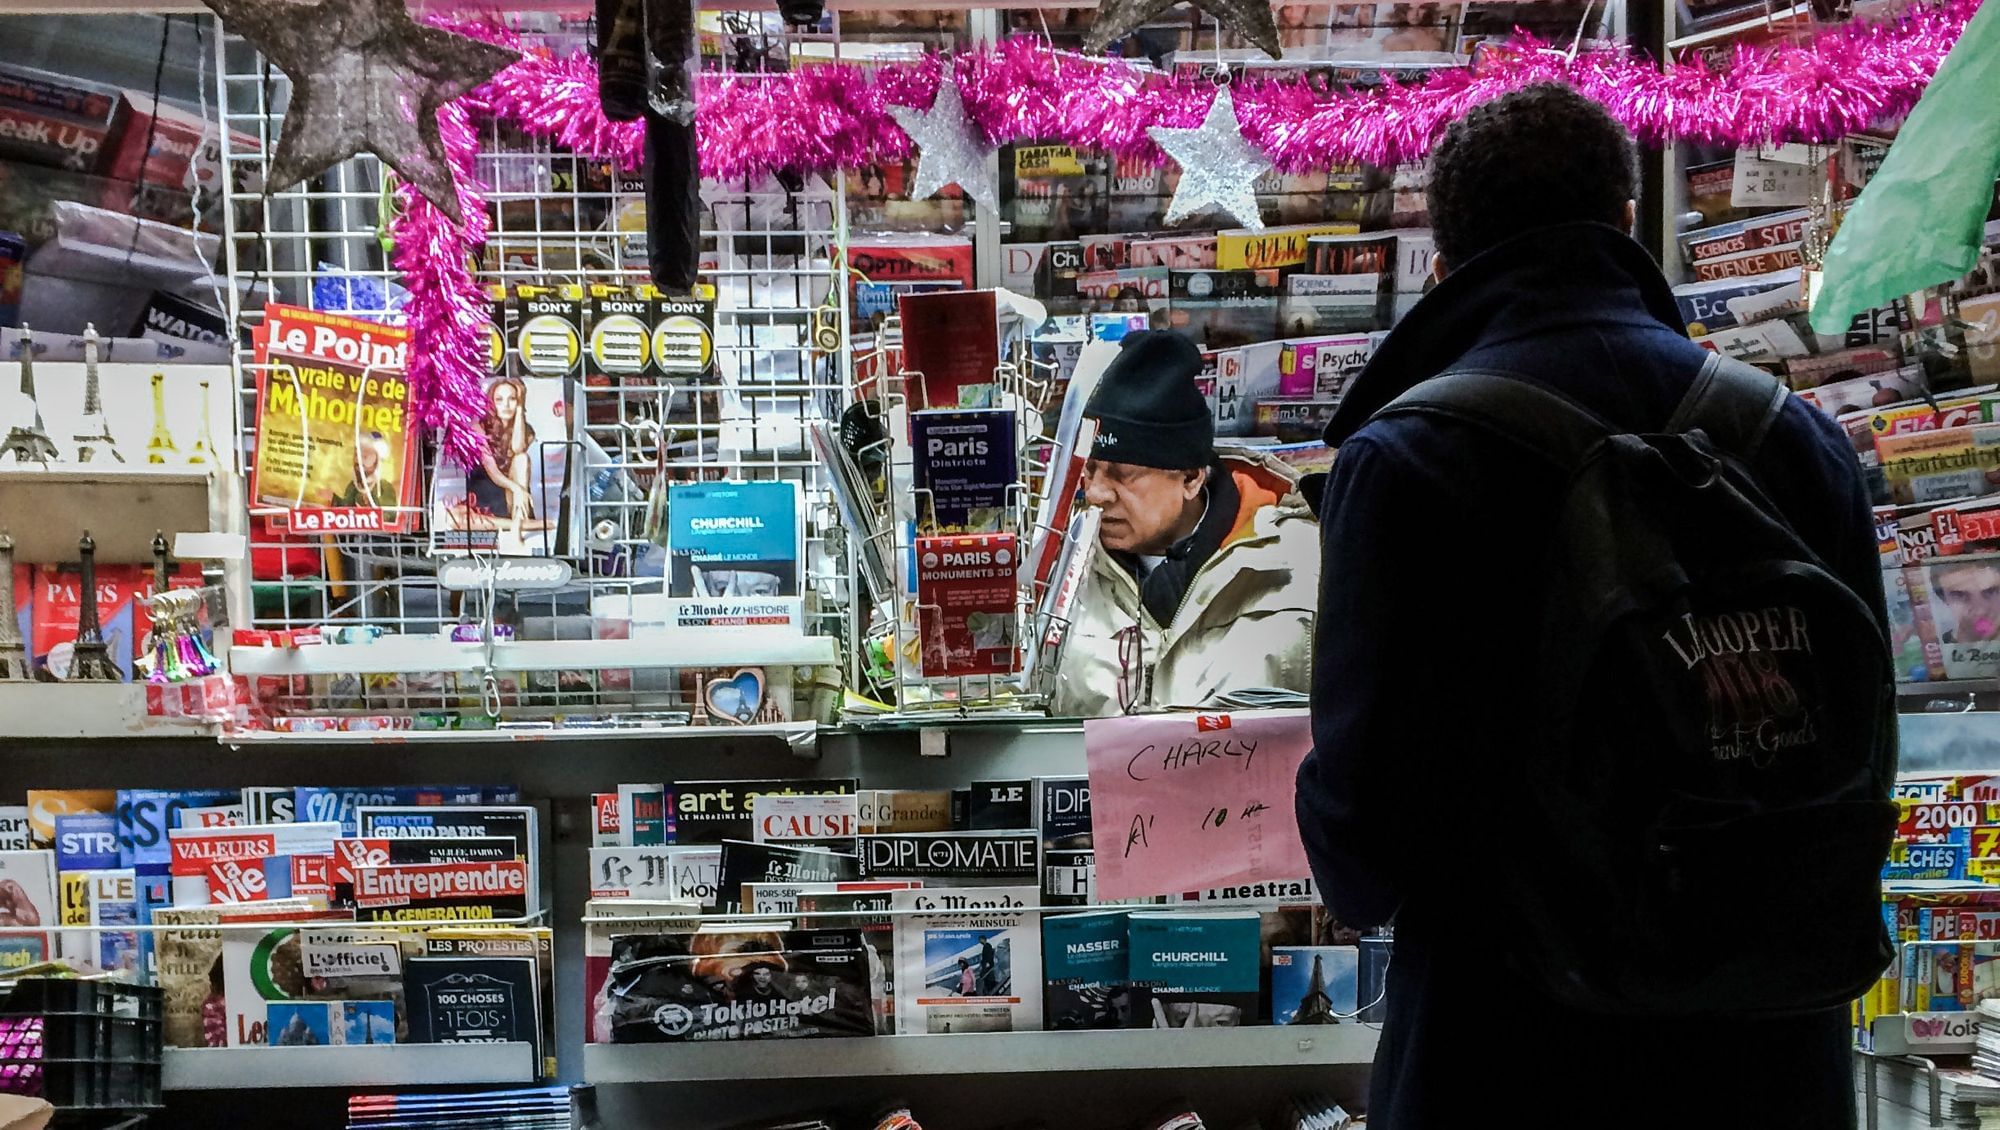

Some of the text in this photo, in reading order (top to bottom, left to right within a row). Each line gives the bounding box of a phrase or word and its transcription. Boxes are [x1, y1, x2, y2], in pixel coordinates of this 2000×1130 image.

[57, 129, 98, 154] Up
[1701, 254, 1765, 281] SCIENCE
[528, 303, 572, 314] SONY
[601, 302, 645, 313] SONY
[661, 302, 705, 313] SONY
[268, 319, 308, 353] Le
[311, 325, 408, 372] Point
[298, 366, 346, 391] vraie
[381, 377, 406, 400] de
[269, 382, 404, 433] Mahomet
[1219, 404, 1236, 421] LA
[927, 436, 990, 457] Paris
[295, 510, 380, 532] Le Point
[690, 516, 765, 529] CHURCHILL
[942, 551, 992, 567] PARIS
[922, 567, 1013, 581] MONUMENTS 3D
[679, 604, 690, 616] Le
[692, 604, 729, 616] Monde
[743, 604, 790, 615] HISTOIRE
[1127, 740, 1258, 781] CHARLY
[678, 788, 733, 813] art
[990, 786, 1023, 803] LE
[878, 804, 946, 823] Grandes
[1202, 808, 1228, 830] 10
[1914, 806, 1978, 830] 2000
[374, 826, 486, 838] GRAND PARIS
[175, 839, 270, 860] VALEURS
[870, 839, 1036, 868] DIPLOMATIE
[765, 859, 838, 881] Le Monde
[364, 864, 525, 898] Entreprendre
[372, 905, 493, 922] LA GENERATION
[910, 895, 1024, 918] Le Monde
[67, 910, 86, 925] de
[969, 919, 1018, 928] MENSUEL
[428, 940, 453, 952] LES
[1066, 940, 1120, 954] NASSER
[1151, 952, 1229, 964] CHURCHILL
[1151, 985, 1185, 994] CHANGÉ
[437, 994, 505, 1005] 100 CHOSES
[699, 987, 836, 1026] Tokio Hotel
[457, 1009, 500, 1028] FOIS
[744, 1015, 800, 1036] POSTER
